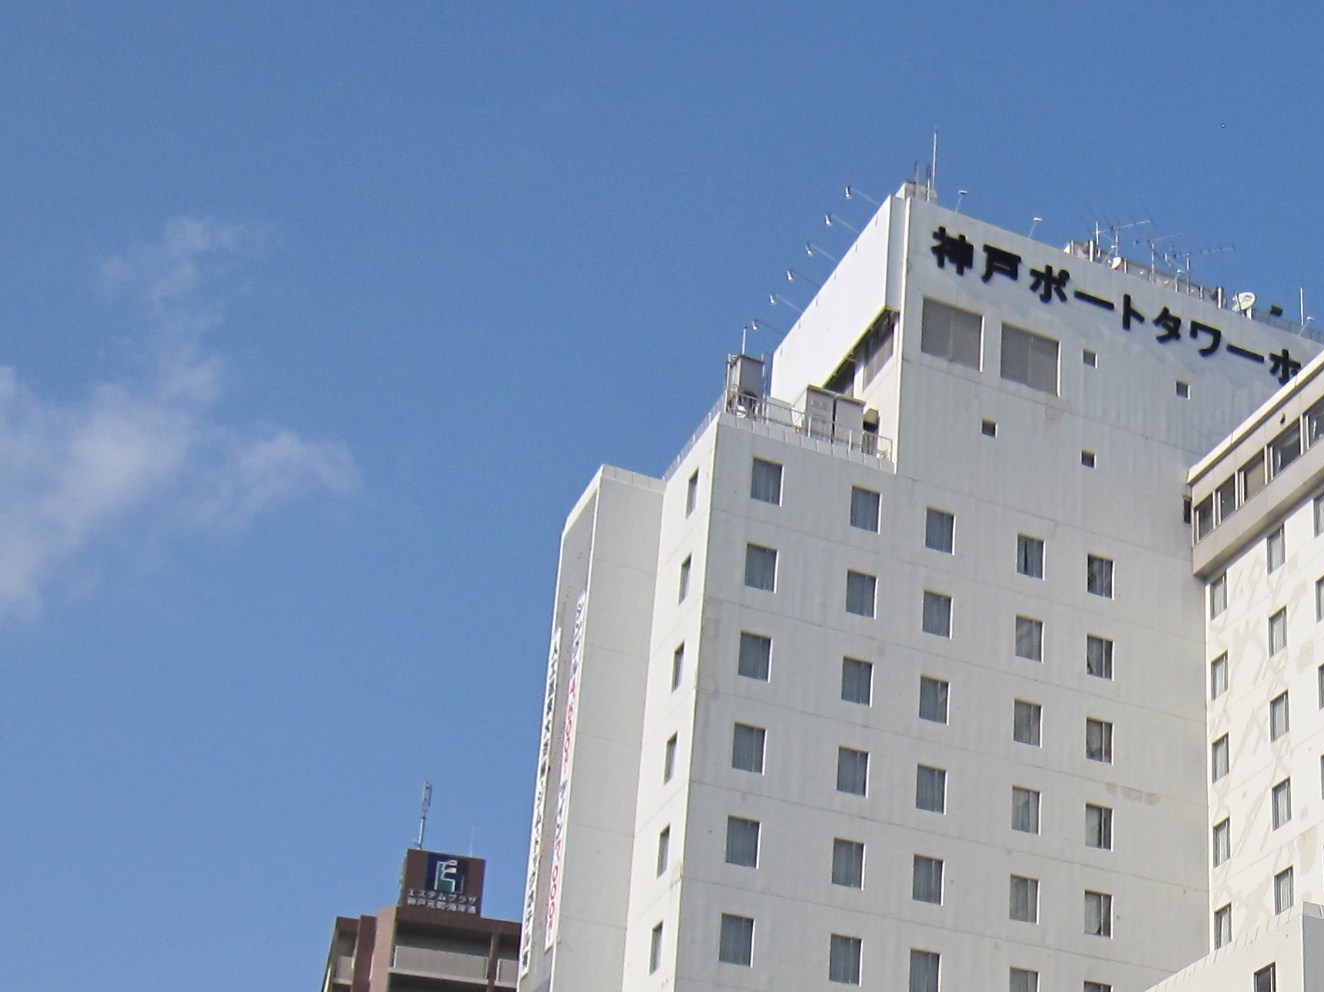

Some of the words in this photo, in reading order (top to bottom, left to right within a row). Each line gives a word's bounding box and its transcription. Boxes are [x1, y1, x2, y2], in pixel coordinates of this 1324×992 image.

[930, 225, 1301, 386] 神戸ポートタワーホ
[408, 889, 478, 904] エステムプラザ
